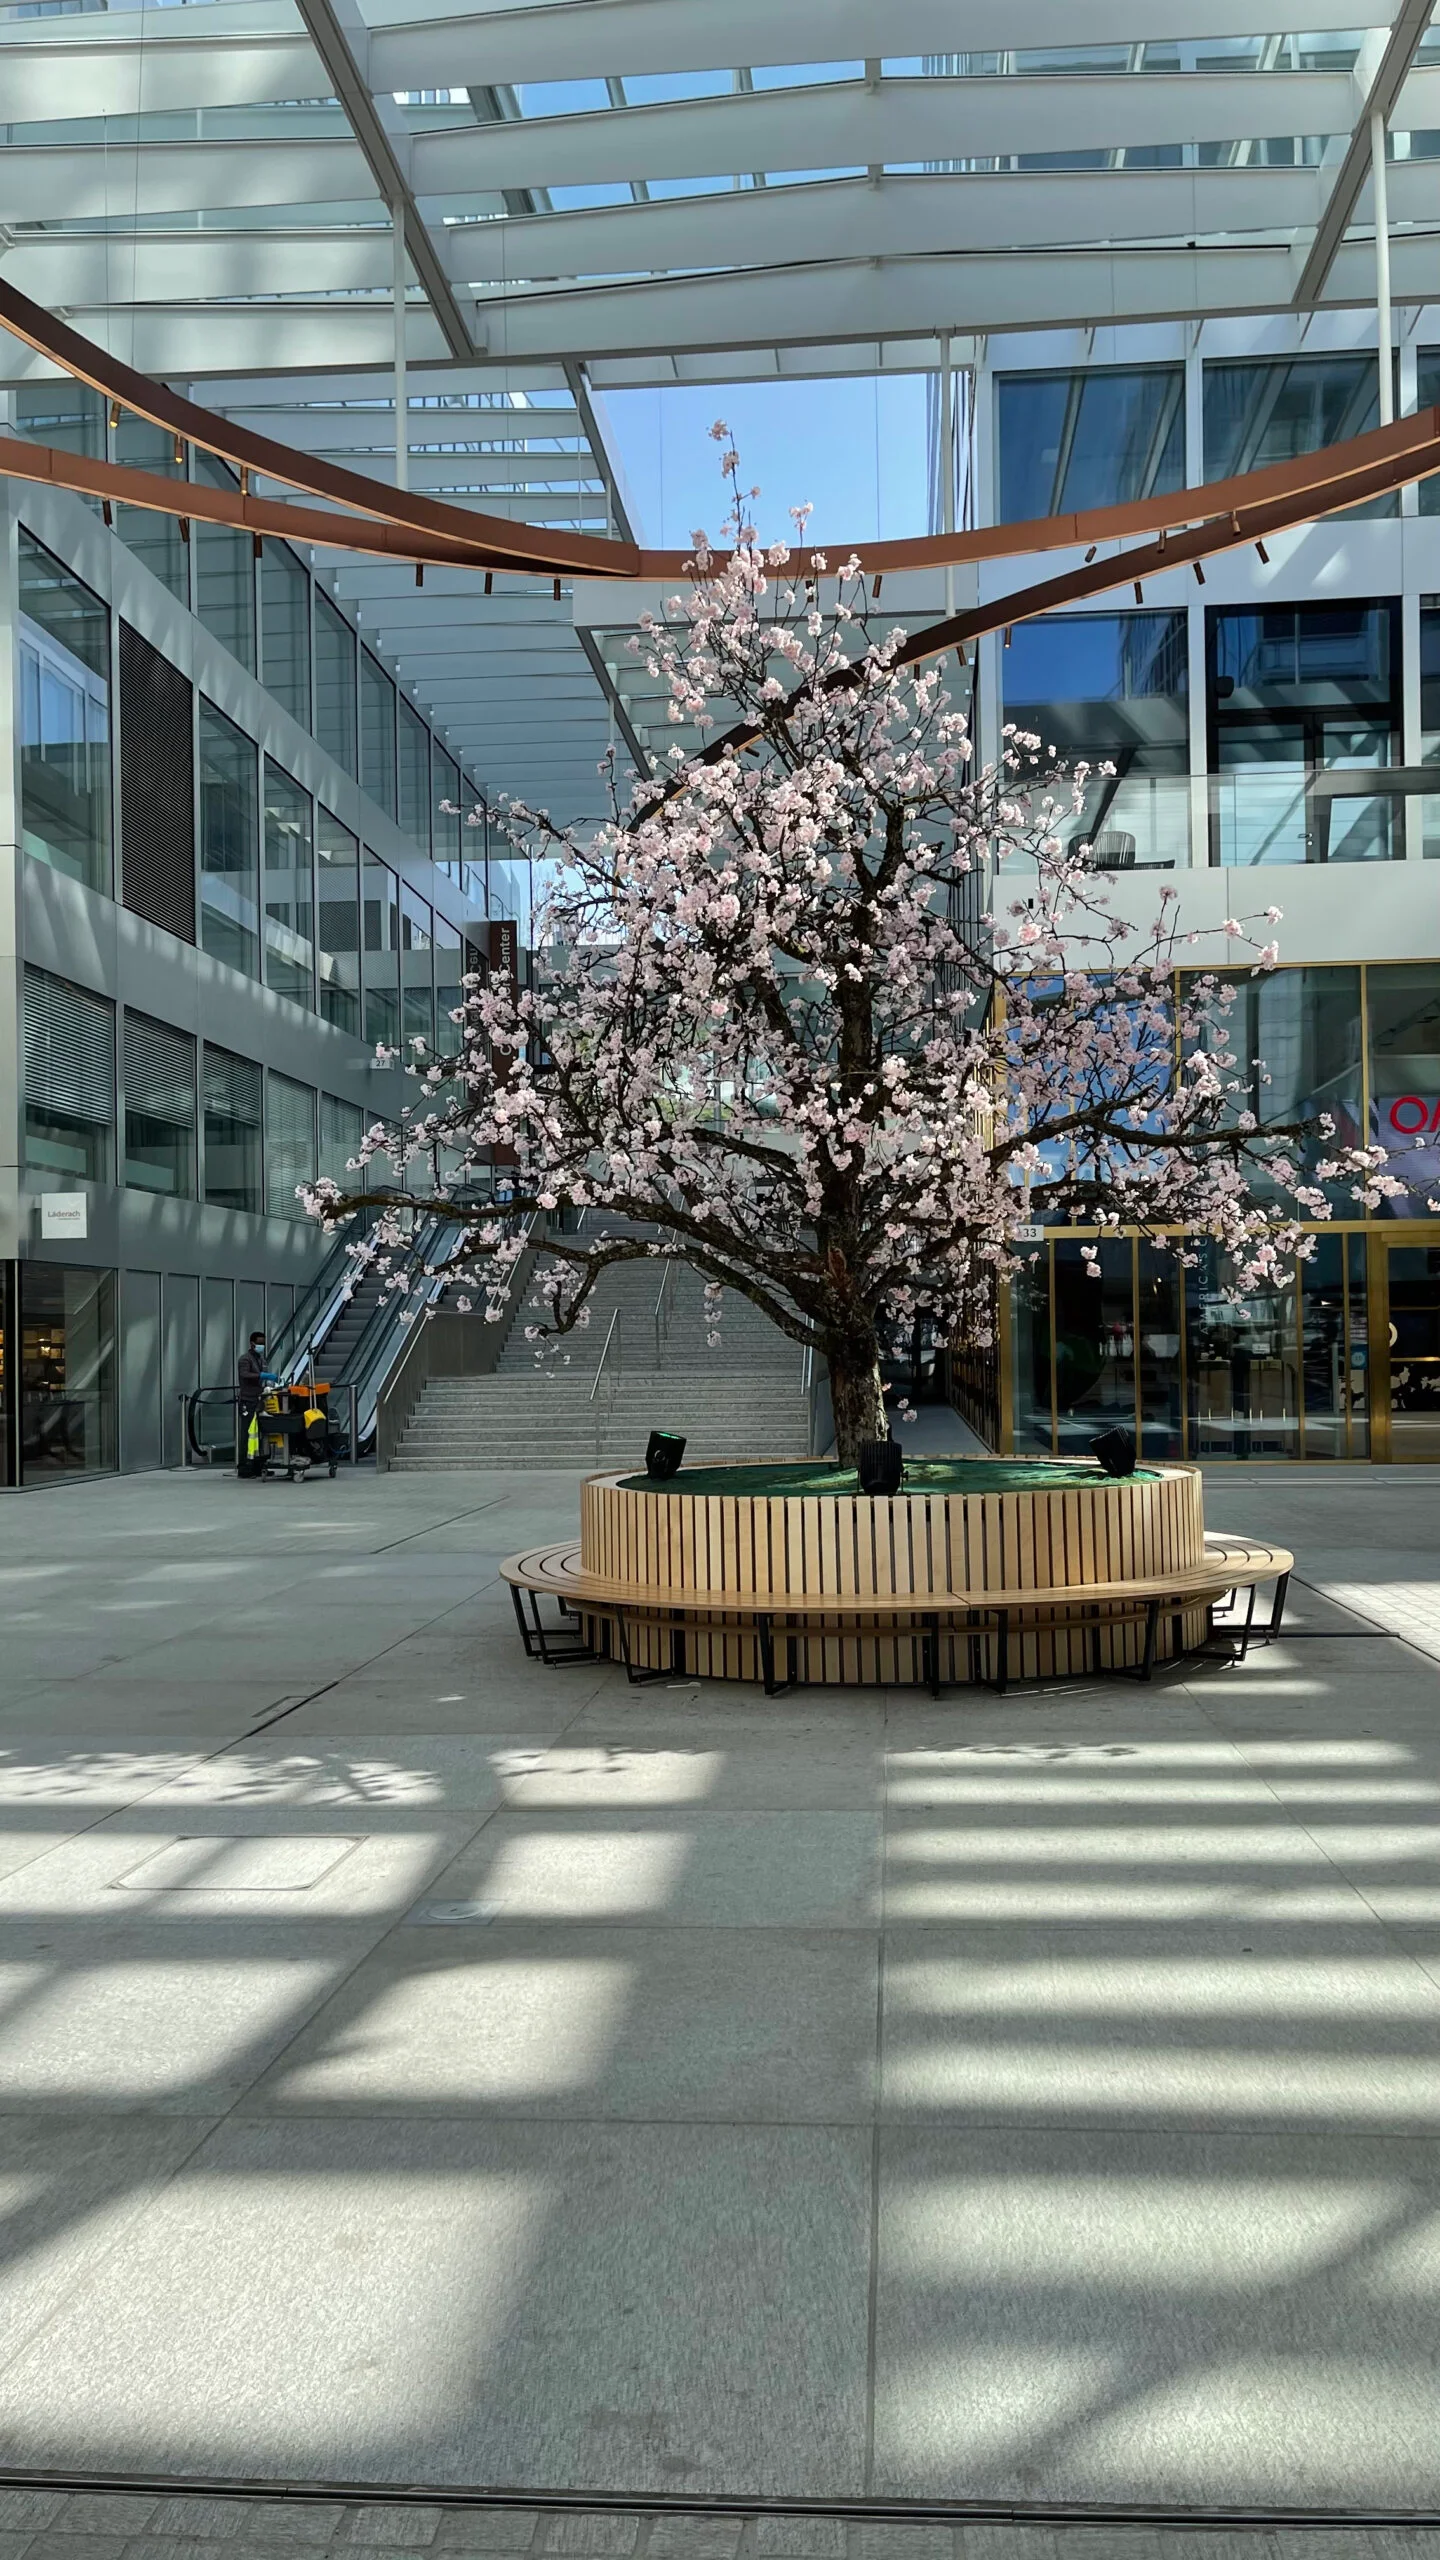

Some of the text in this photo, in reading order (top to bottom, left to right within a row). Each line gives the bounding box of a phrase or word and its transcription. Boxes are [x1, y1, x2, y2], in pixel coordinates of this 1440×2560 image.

[499, 928, 511, 974] Center
[1389, 1095, 1440, 1134] O
[48, 1209, 81, 1218] Läderach
[1023, 1228, 1037, 1238] 33
